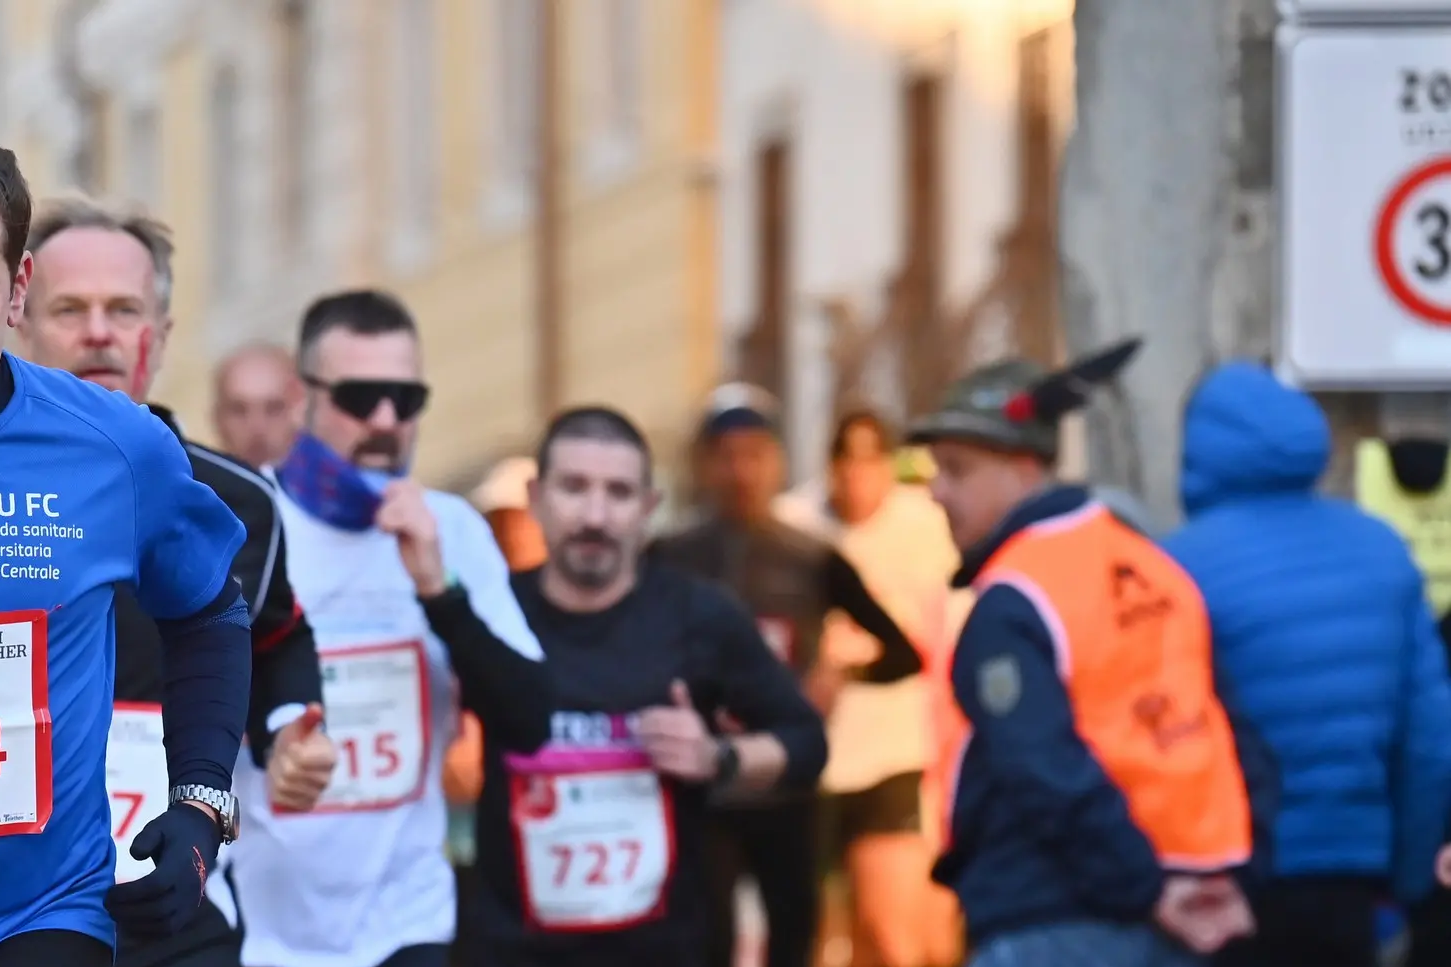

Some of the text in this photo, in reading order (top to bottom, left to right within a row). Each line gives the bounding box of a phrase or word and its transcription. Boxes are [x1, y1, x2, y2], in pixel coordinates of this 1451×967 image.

[26, 493, 60, 518] FC
[23, 524, 84, 539] sanitaria
[0, 563, 60, 579] Centrale
[549, 839, 642, 888] 727
